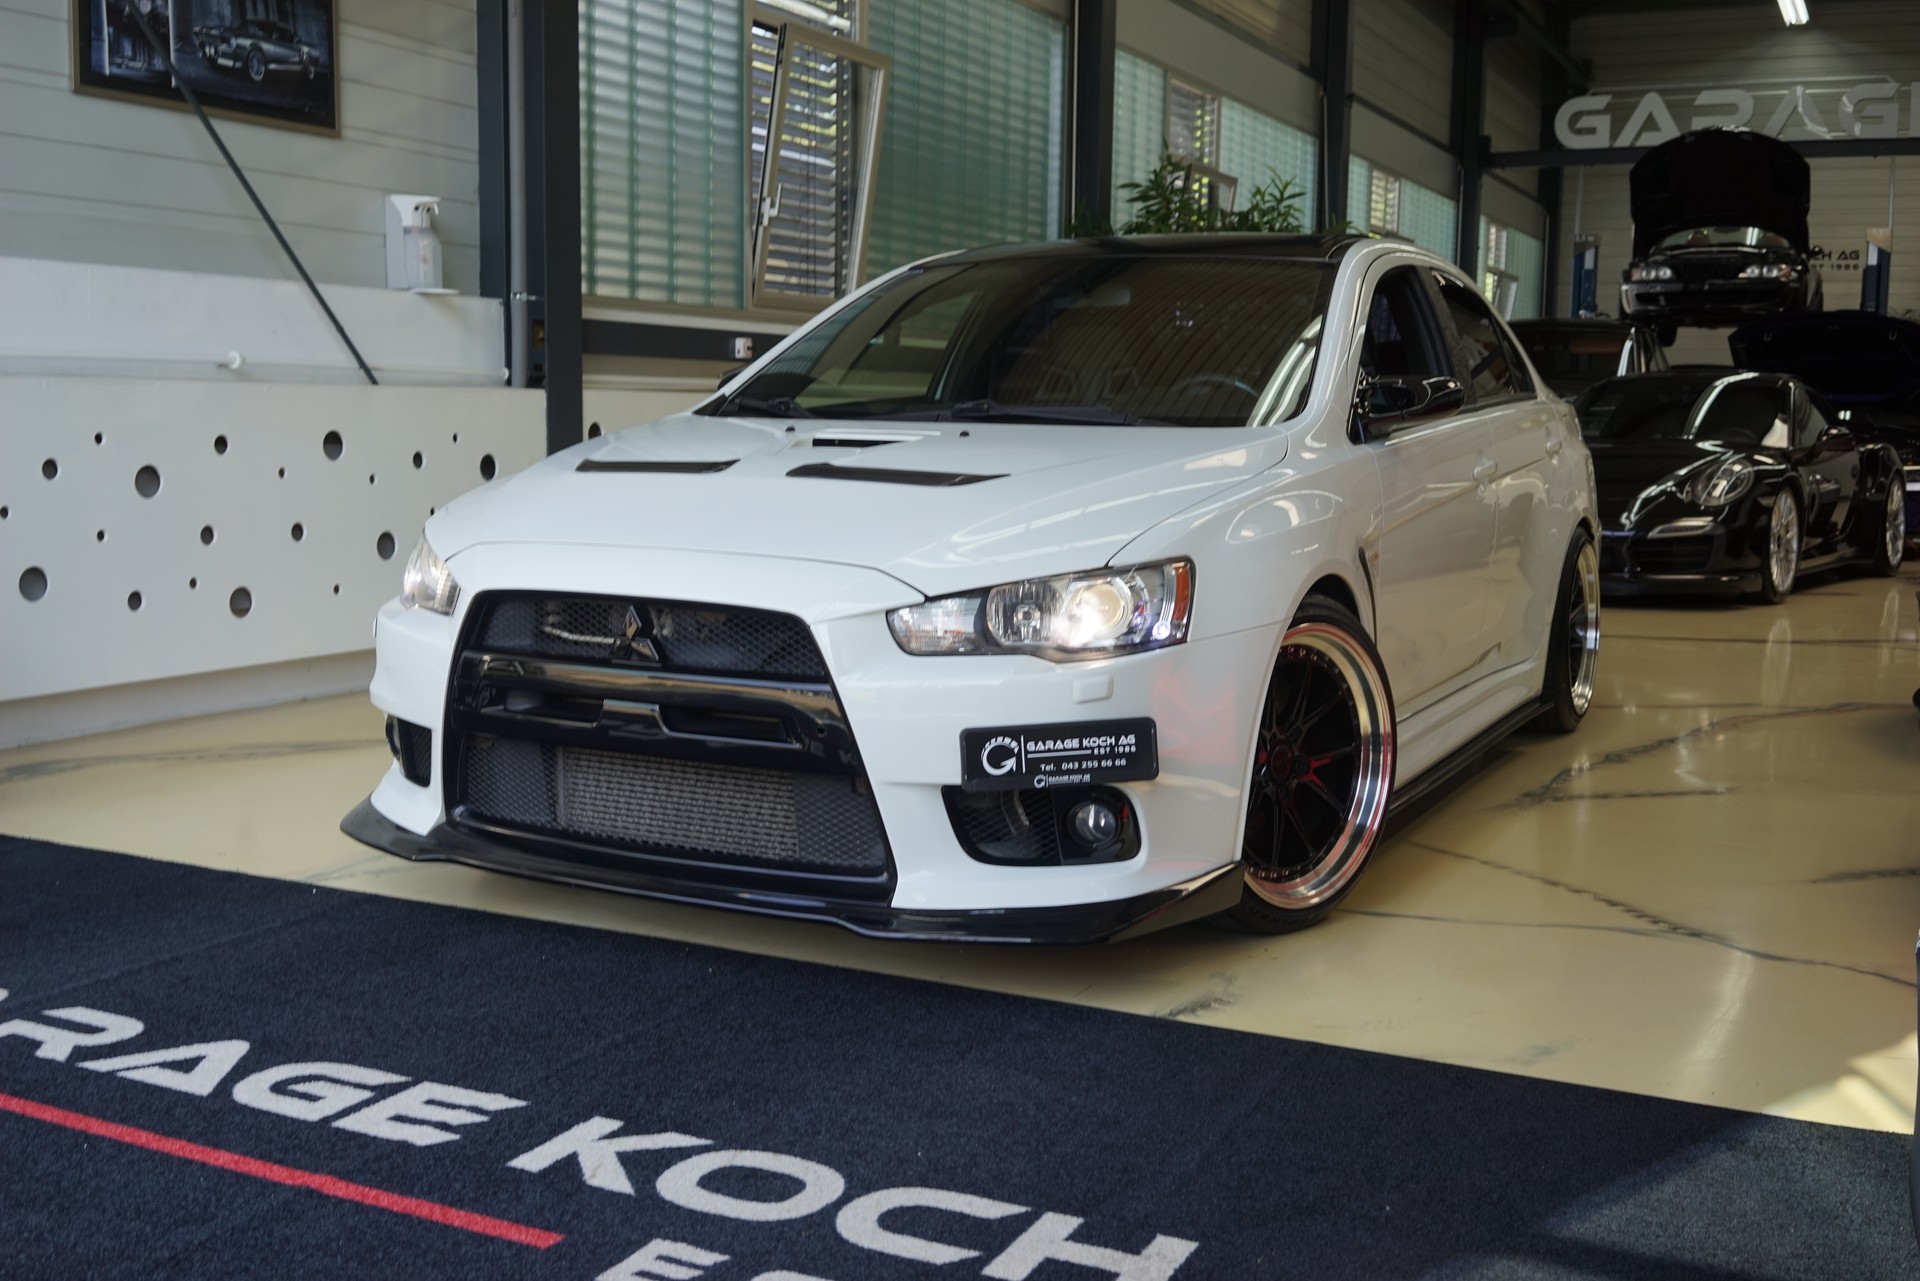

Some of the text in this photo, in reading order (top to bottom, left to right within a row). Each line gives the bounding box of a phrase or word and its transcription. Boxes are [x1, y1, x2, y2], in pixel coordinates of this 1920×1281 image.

[1554, 82, 1920, 150] GARAG
[1837, 249, 1860, 261] AG
[1026, 734, 1136, 752] GARAGE KOCH AG
[1061, 760, 1079, 771] 043
[0, 987, 1200, 1281] RAGE KOCH
